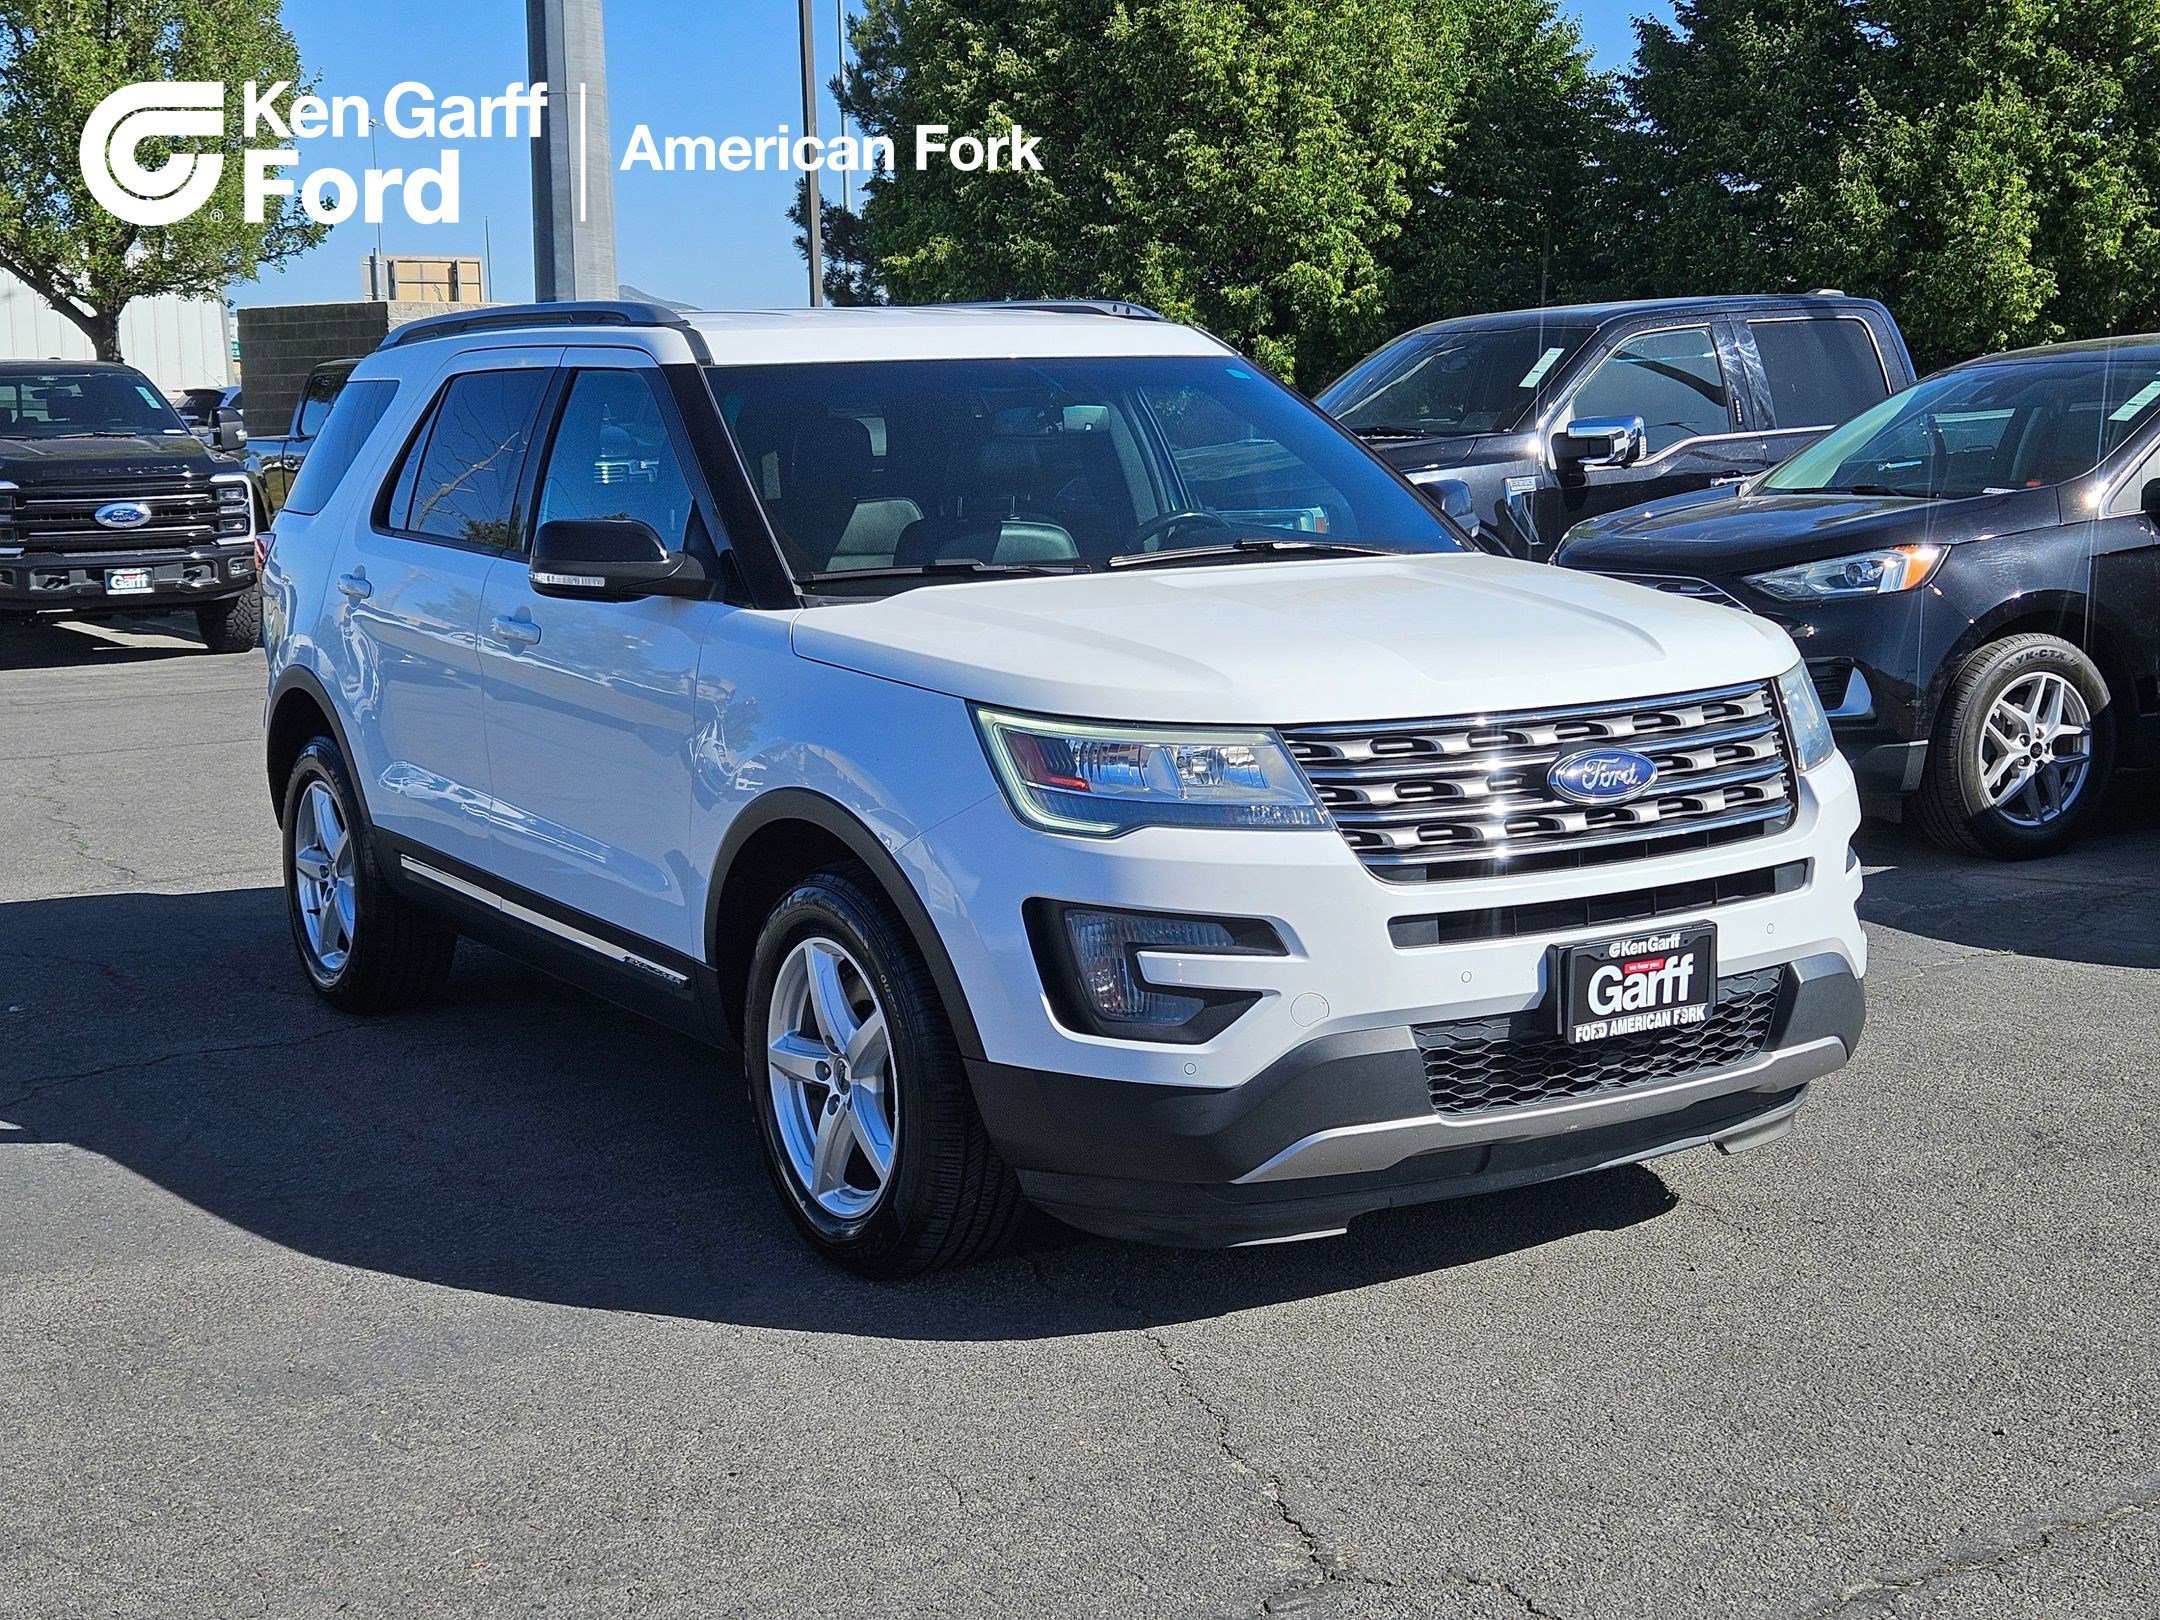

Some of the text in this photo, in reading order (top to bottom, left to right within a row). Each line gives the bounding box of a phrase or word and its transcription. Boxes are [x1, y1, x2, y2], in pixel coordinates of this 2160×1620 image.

[110, 573, 148, 590] Garff
[1581, 757, 1642, 790] Ford
[1620, 933, 1681, 957] Ken Garff
[1588, 953, 1694, 1016] Garff
[1609, 1010, 1671, 1037] AMERICAN
